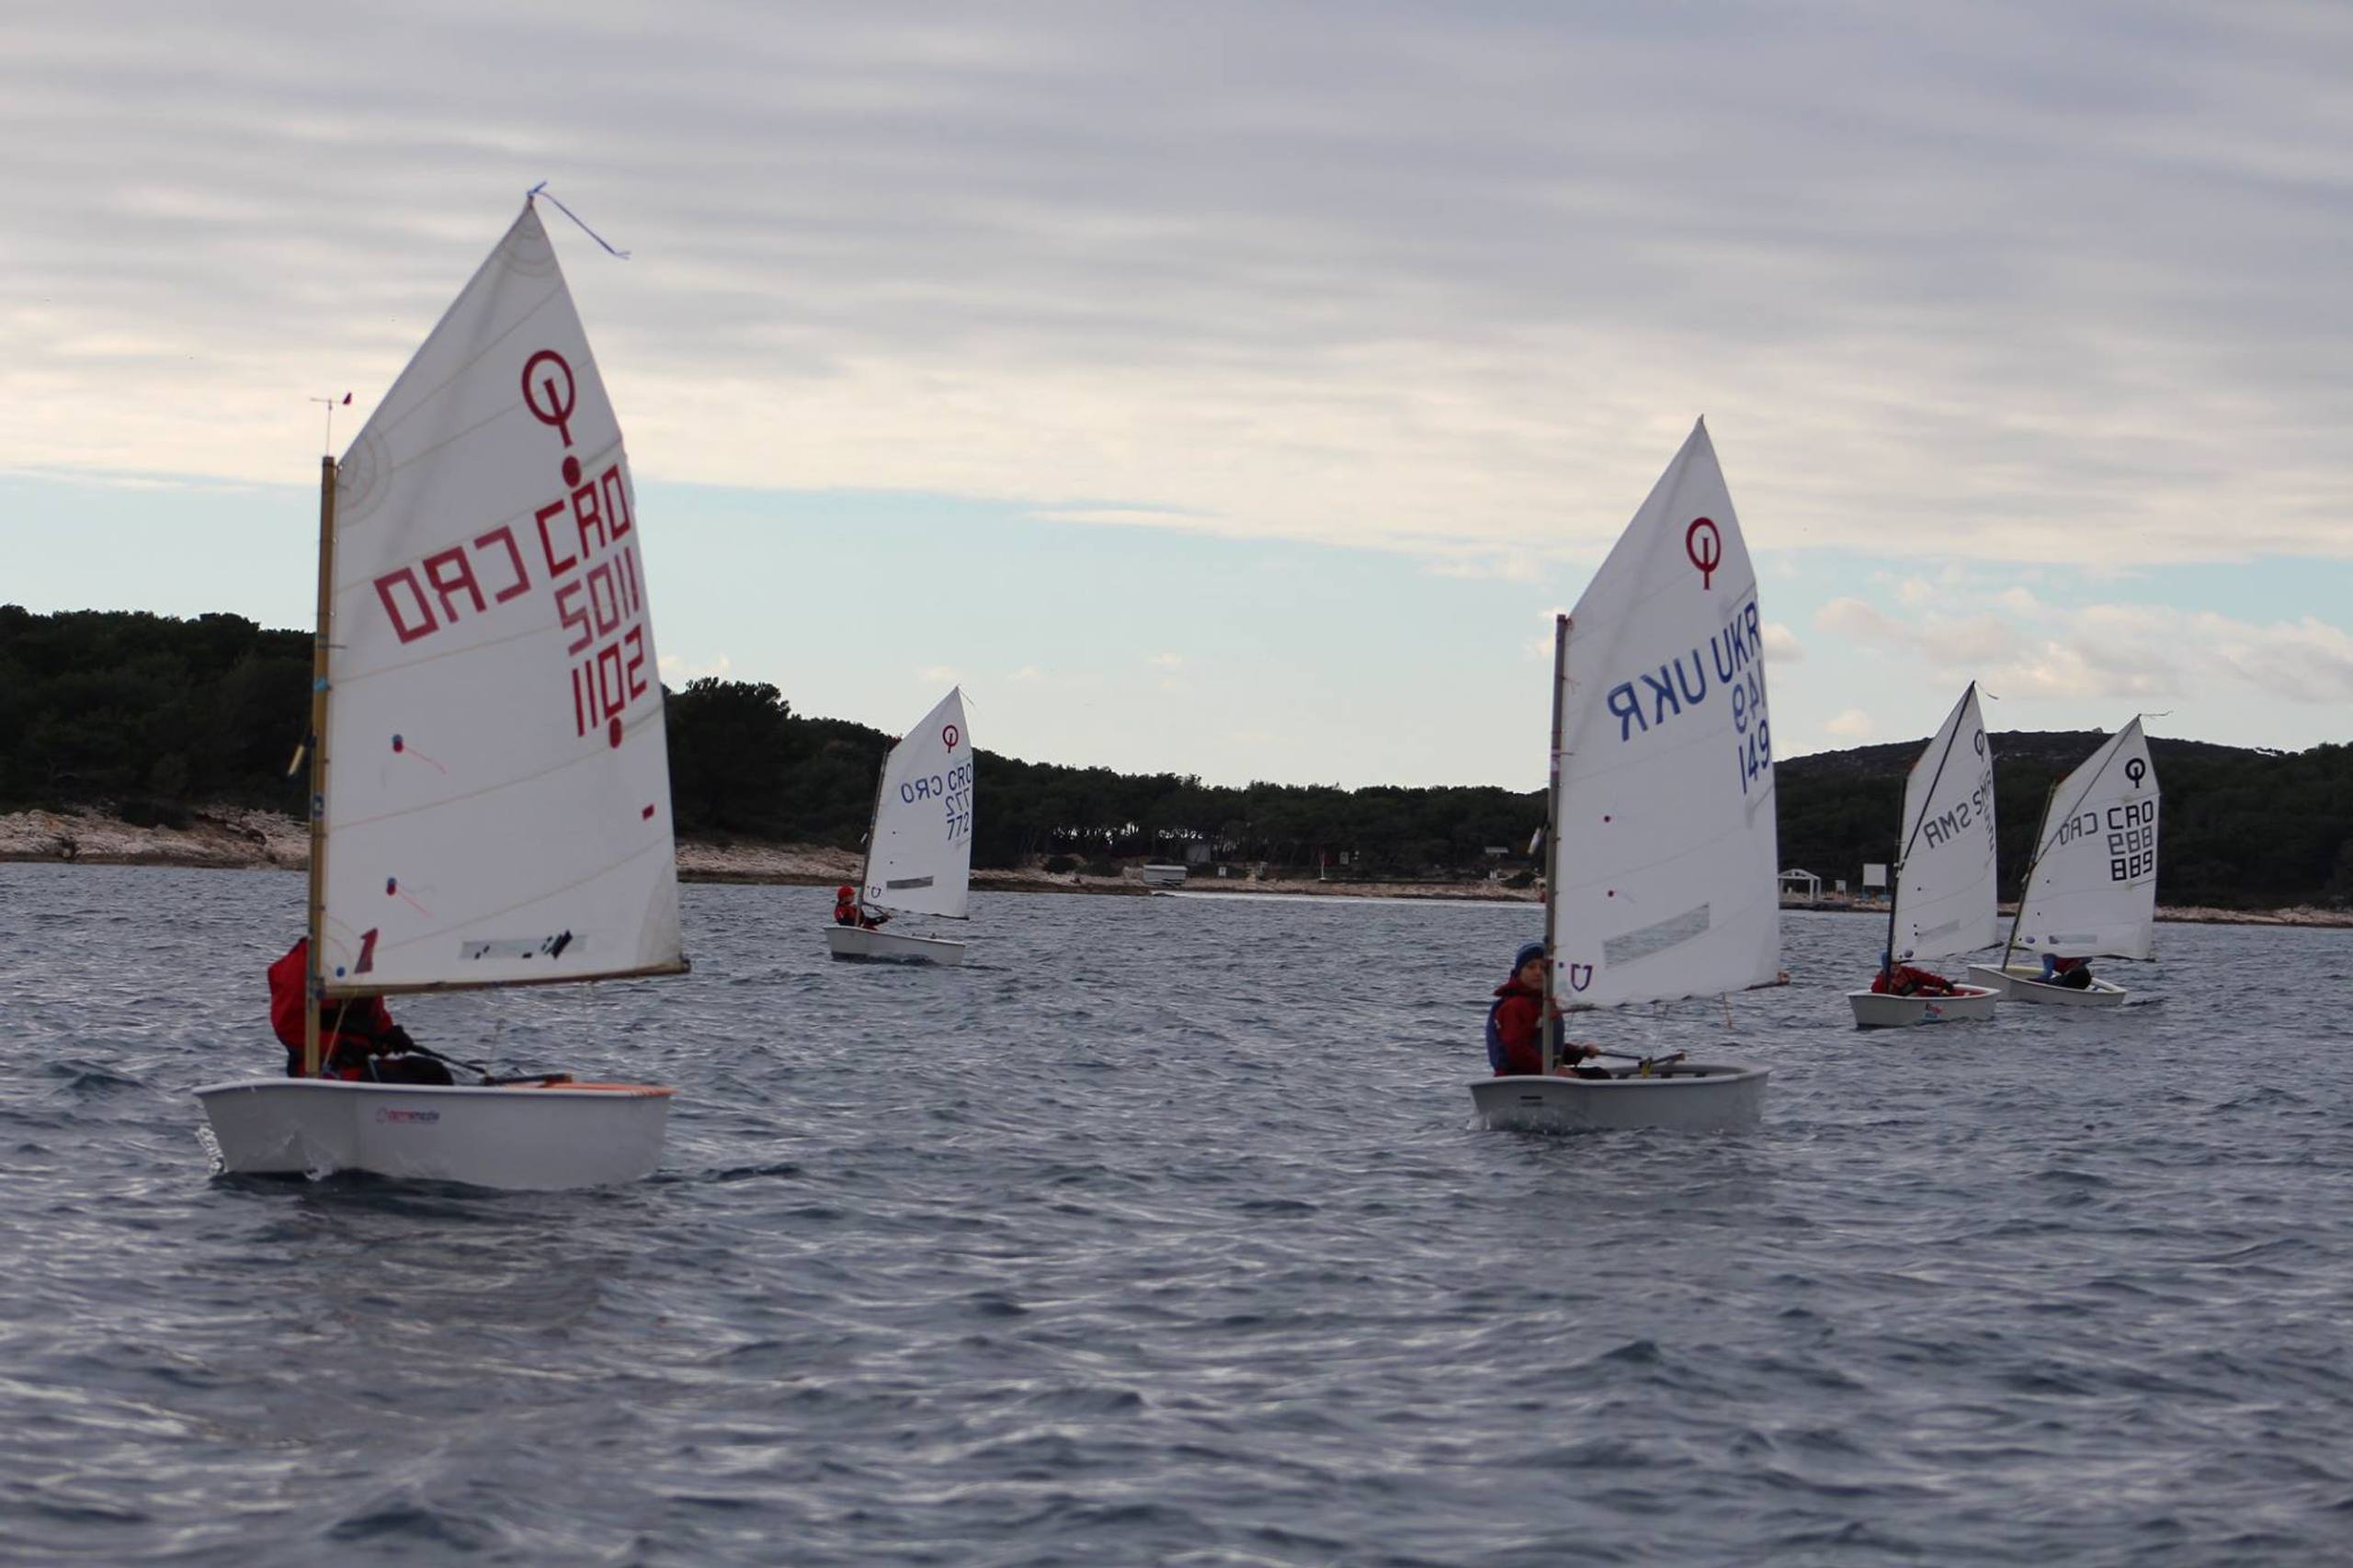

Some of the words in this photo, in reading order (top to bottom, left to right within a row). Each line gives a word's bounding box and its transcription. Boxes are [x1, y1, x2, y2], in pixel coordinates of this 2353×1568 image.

[534, 464, 631, 579] CRO
[1711, 601, 1761, 684] UKR
[573, 623, 648, 737] 1102
[948, 762, 972, 792] CRO
[1739, 719, 1770, 795] 149
[947, 812, 970, 840] 772
[2107, 800, 2154, 829] CRO
[2110, 849, 2154, 881] 889
